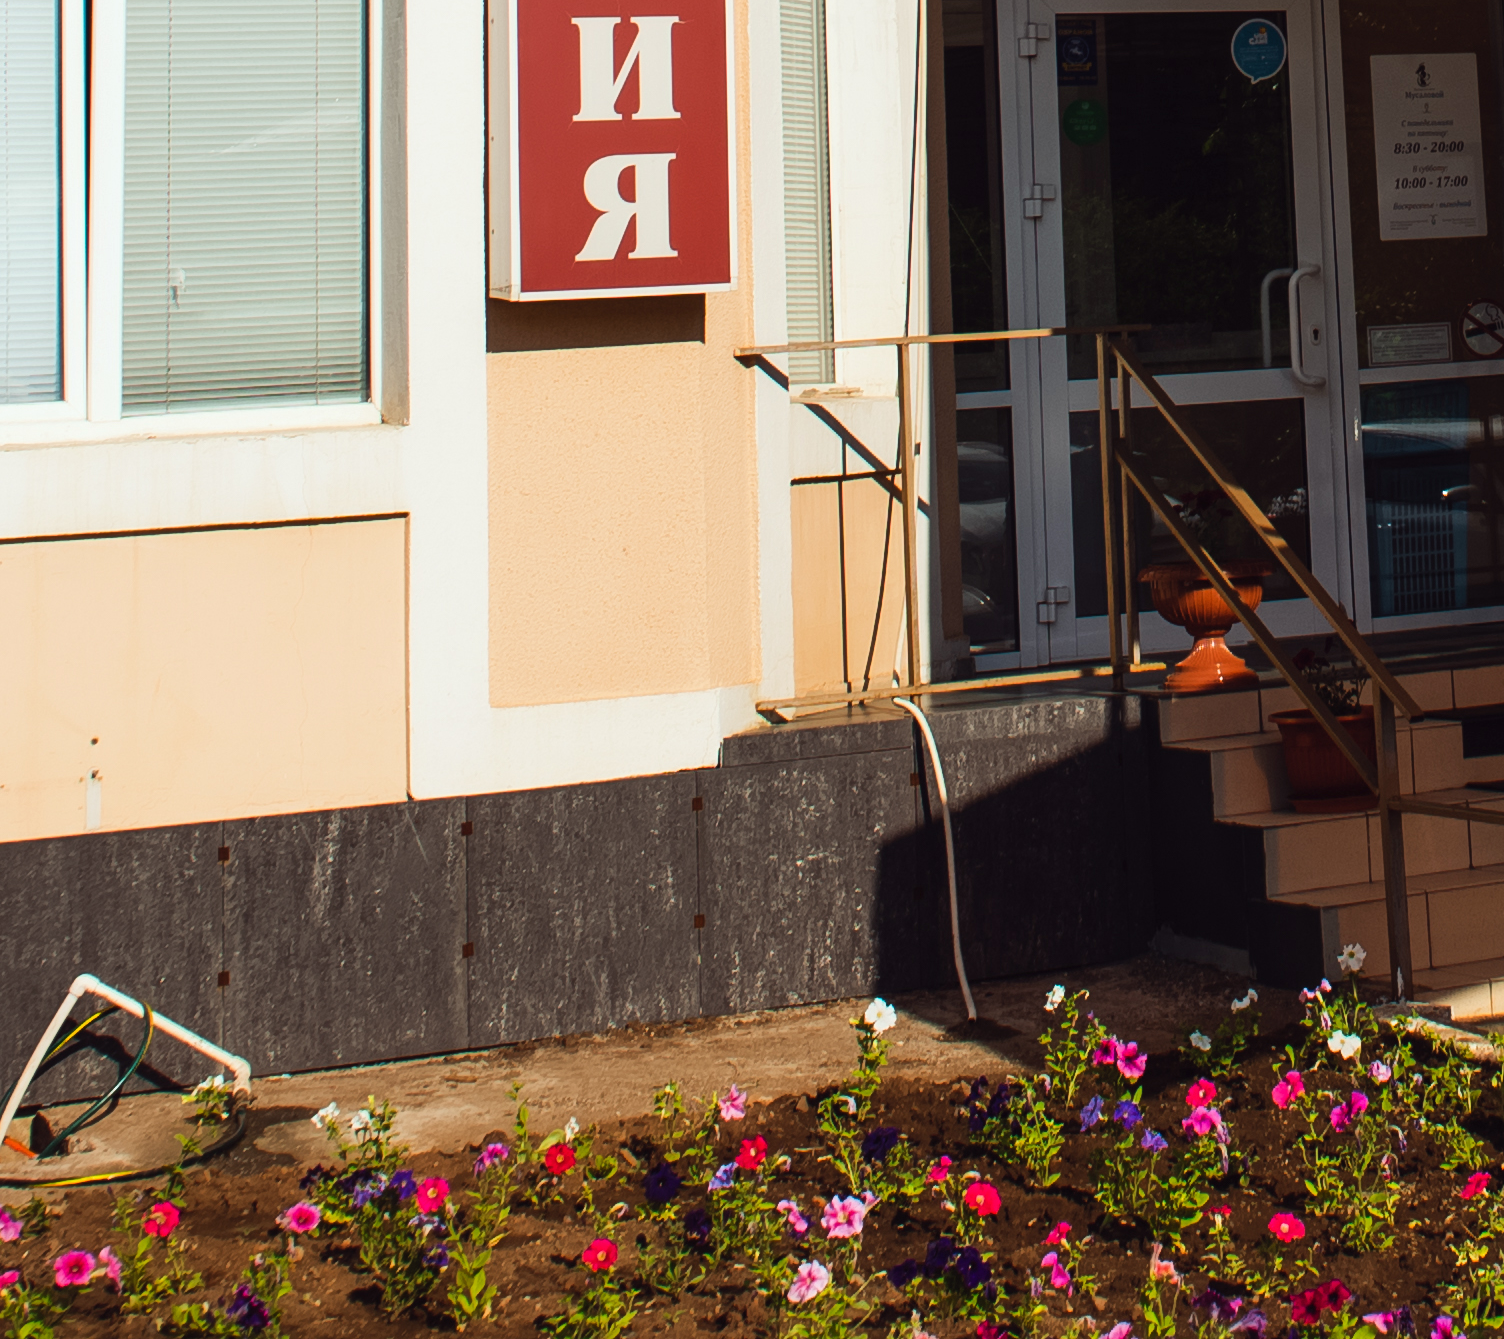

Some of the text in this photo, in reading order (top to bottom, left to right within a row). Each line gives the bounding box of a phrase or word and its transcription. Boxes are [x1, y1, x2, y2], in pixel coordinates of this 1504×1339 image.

[1393, 142, 1420, 153] 8:30
[1430, 140, 1464, 152] 20:00
[1394, 177, 1426, 189] 10:00
[1436, 175, 1468, 188] 17:00
